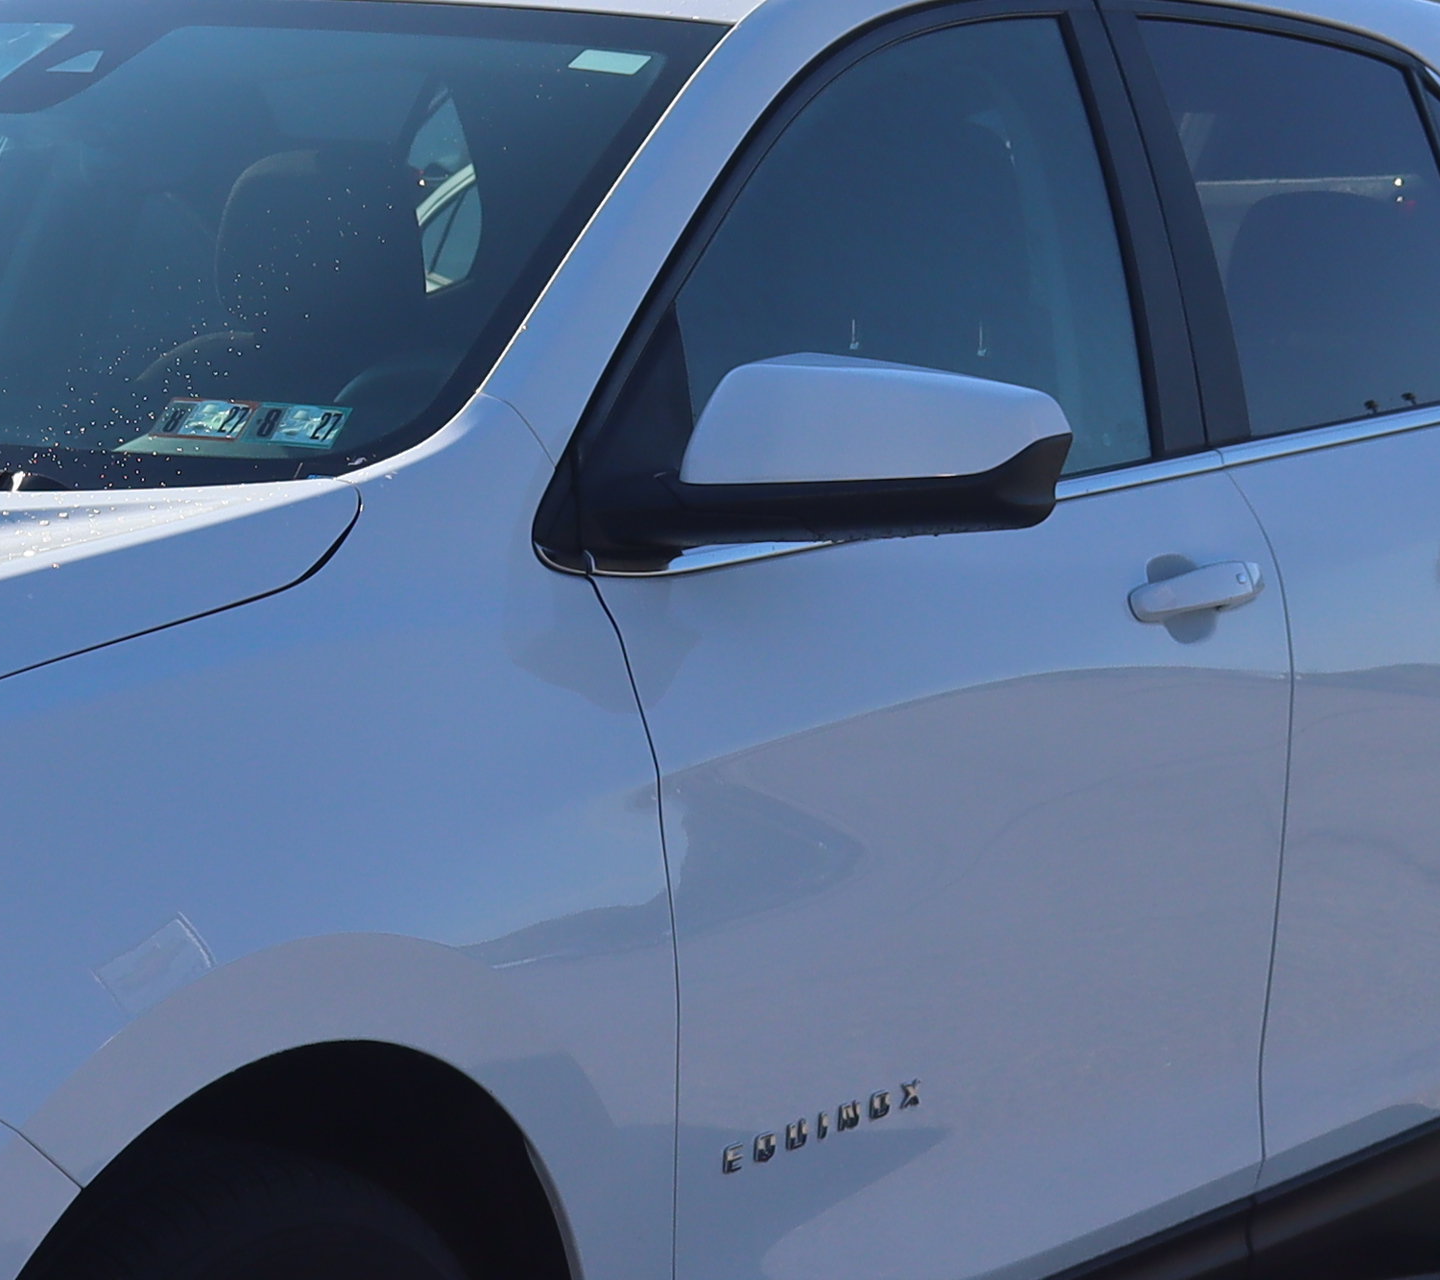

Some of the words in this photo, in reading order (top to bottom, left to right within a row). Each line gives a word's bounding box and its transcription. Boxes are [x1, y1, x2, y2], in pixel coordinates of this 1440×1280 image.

[217, 405, 250, 436] 27
[310, 412, 344, 442] 27
[722, 1078, 921, 1174] EQUINOX
